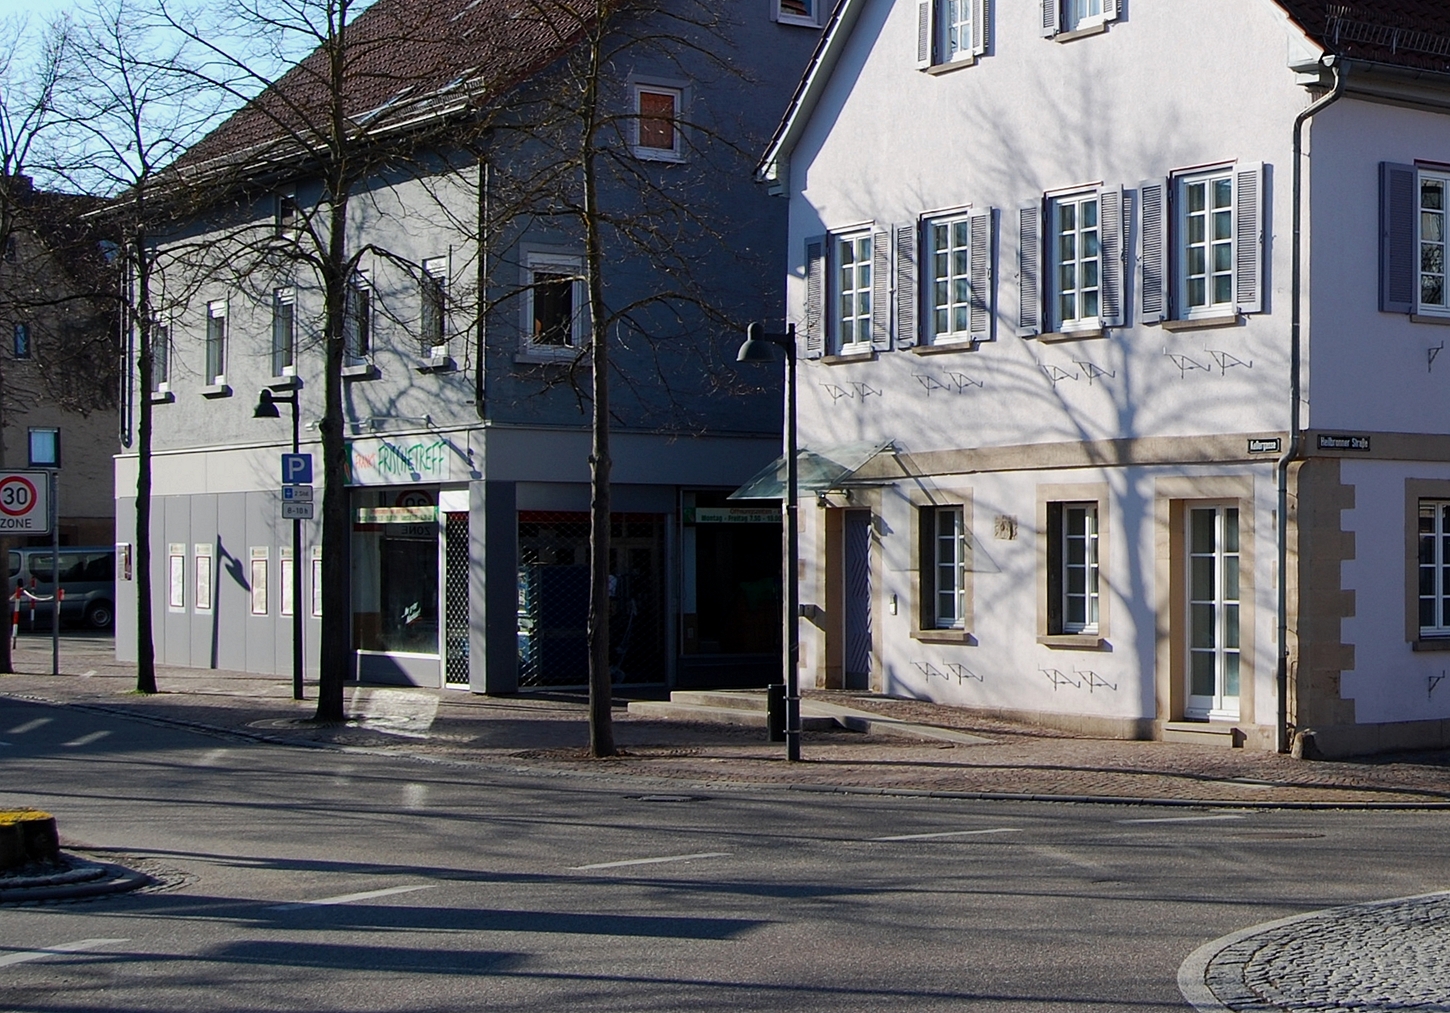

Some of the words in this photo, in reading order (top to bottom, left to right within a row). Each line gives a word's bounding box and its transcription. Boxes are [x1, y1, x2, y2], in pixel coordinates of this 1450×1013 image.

[288, 457, 306, 481] P
[3, 487, 28, 505] 30
[0, 518, 32, 529] ZONE
